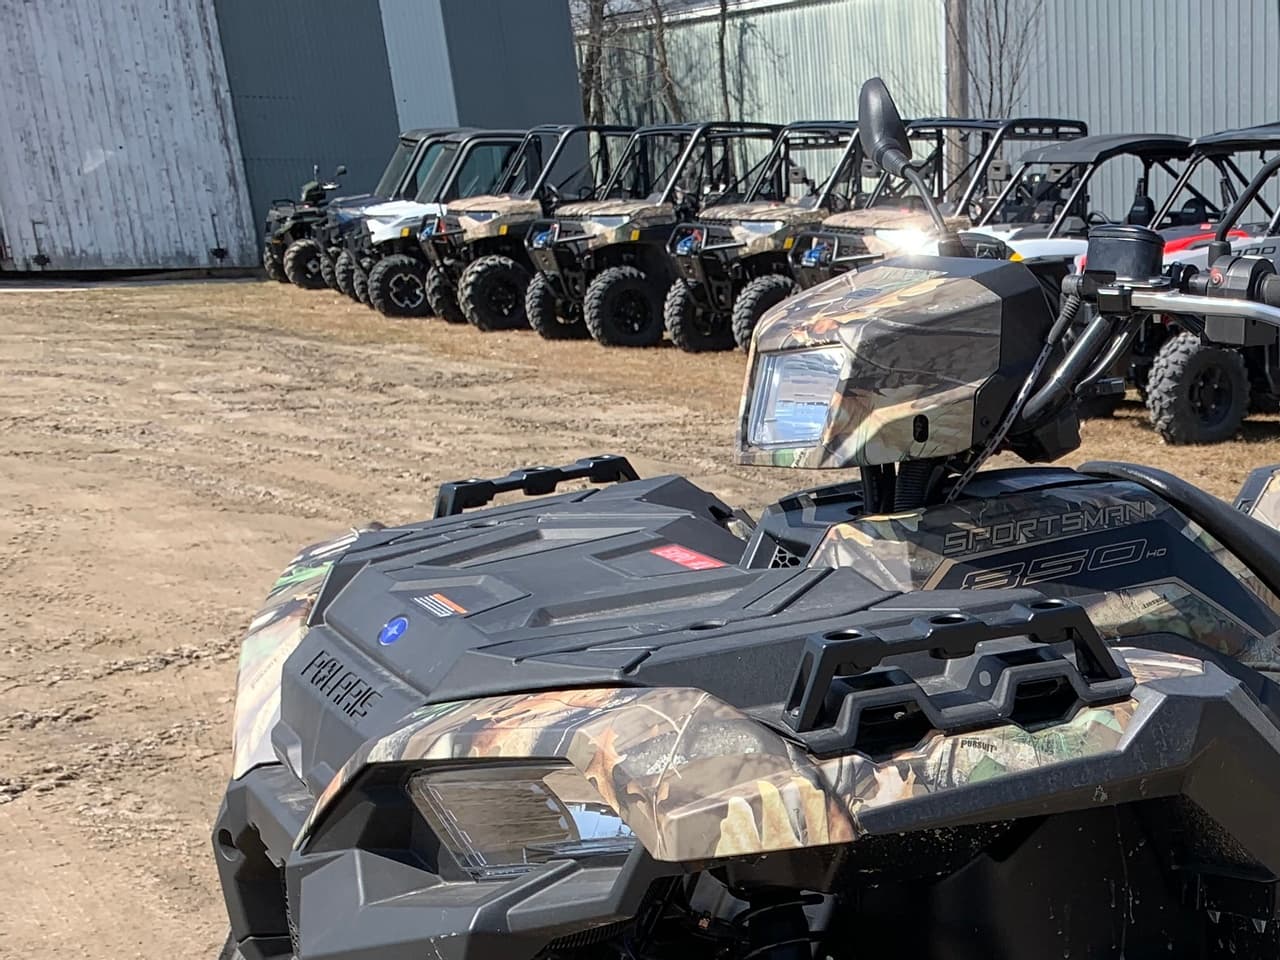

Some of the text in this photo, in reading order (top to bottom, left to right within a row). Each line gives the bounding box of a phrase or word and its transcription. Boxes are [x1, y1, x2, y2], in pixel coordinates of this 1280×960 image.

[943, 502, 1148, 555] SPORTSMAN
[961, 538, 1168, 591] 850 HD
[300, 649, 384, 725] POLARIS
